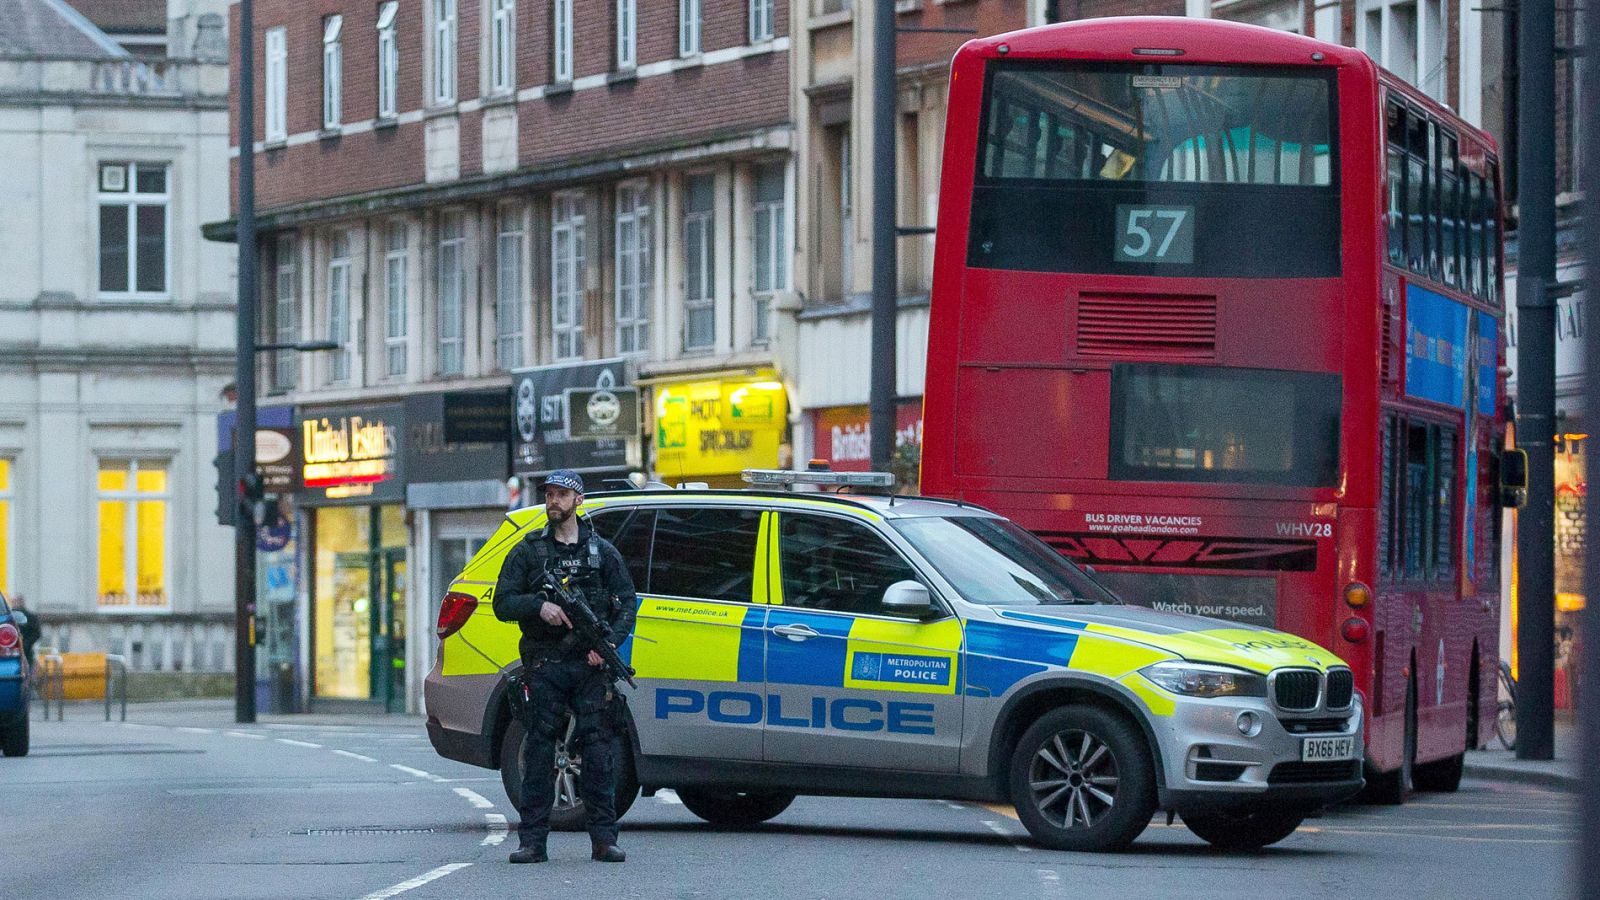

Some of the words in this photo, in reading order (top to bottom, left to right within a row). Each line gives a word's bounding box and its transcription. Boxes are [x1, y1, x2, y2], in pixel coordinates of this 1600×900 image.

[1123, 209, 1186, 258] 57
[303, 418, 348, 462] United
[1085, 513, 1105, 523] BUS
[1107, 514, 1142, 524] DRIVER
[1145, 516, 1202, 526] VACANCIES
[1089, 523, 1198, 534] www.goaheadlondon.com
[1275, 522, 1332, 537] WHV28
[562, 559, 582, 567] POLICE
[655, 605, 728, 617] www.met.police.uk
[1152, 601, 1192, 616] Watch
[1195, 604, 1226, 616] your
[1226, 604, 1266, 618] speed.
[887, 658, 947, 669] METROPOLITAN
[894, 669, 937, 680] POLICE
[655, 687, 936, 735] POLICE
[1308, 741, 1333, 758] BX66
